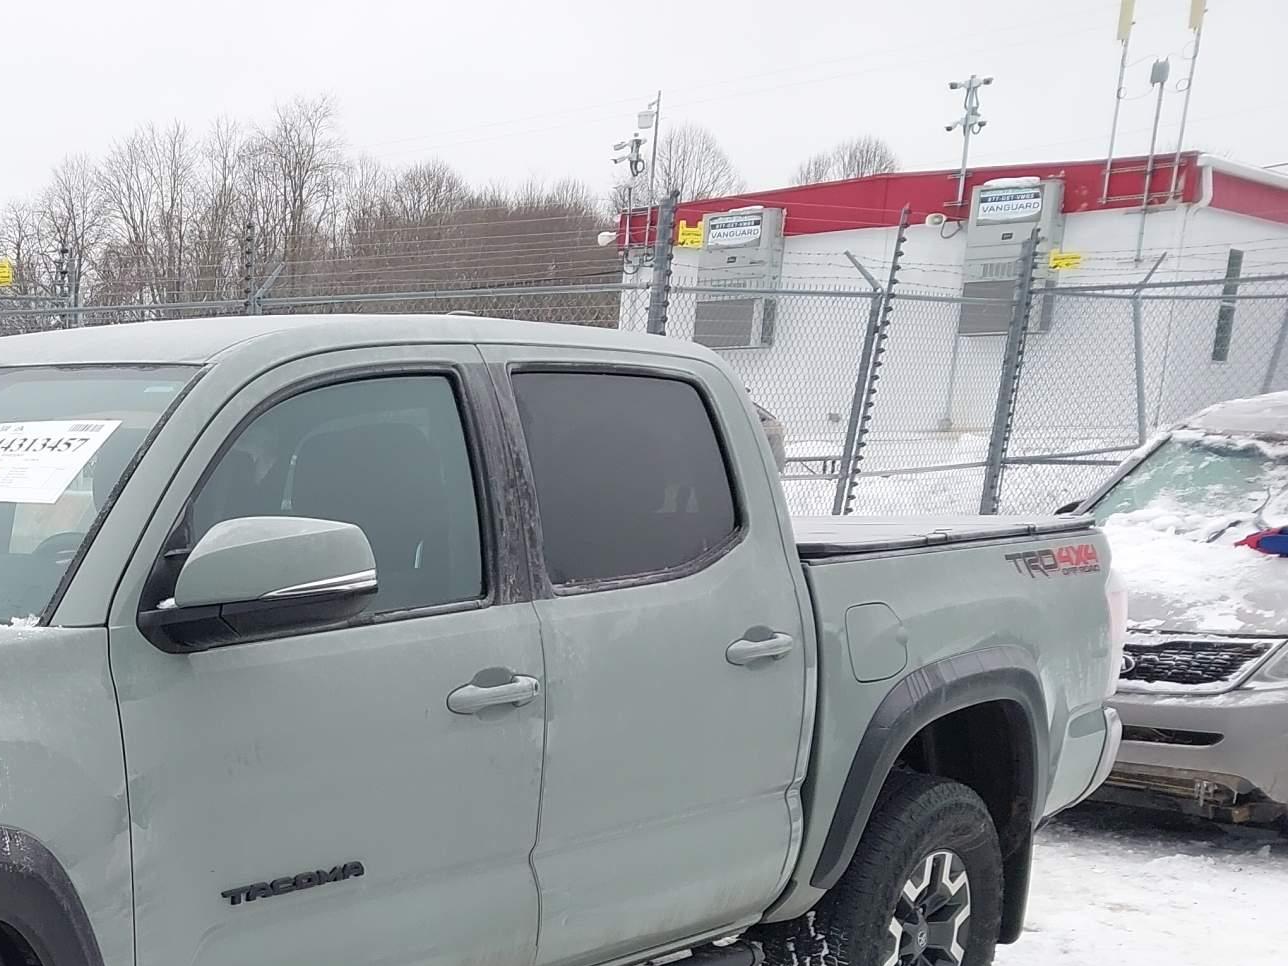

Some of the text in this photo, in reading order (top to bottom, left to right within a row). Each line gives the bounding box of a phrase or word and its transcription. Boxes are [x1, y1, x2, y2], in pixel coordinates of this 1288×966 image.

[982, 202, 1040, 213] VANGUARD
[711, 228, 760, 239] VANGUARD
[1004, 548, 1059, 578] TRD
[220, 860, 365, 906] TACOMA
